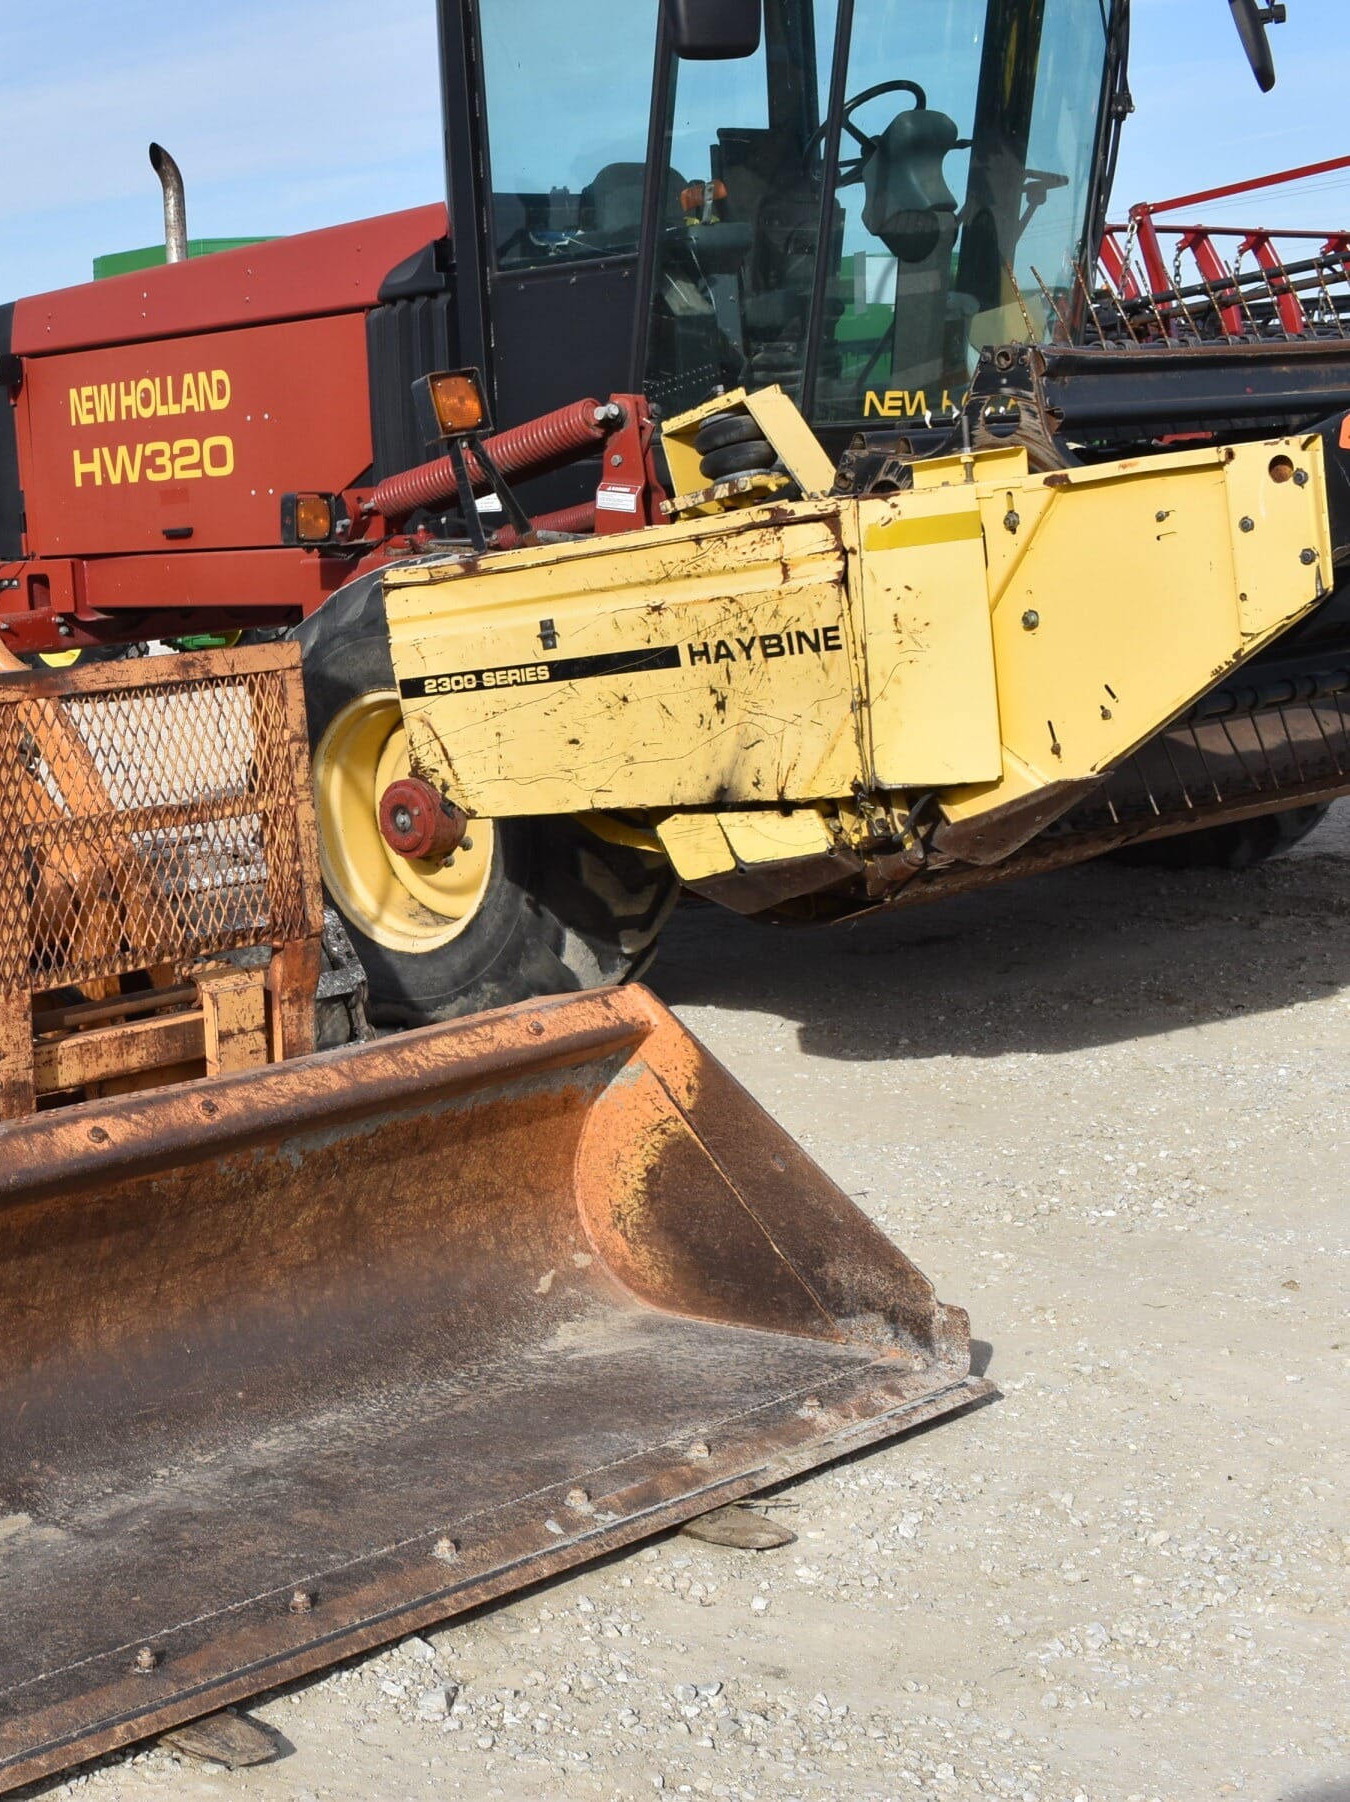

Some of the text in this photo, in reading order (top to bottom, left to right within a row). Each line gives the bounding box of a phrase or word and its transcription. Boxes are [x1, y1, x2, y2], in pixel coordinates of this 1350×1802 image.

[69, 369, 231, 426] NEW HOLLAND
[73, 436, 234, 487] HW320
[687, 625, 843, 666] HAYBINE
[424, 665, 550, 694] 2300 SERIES
